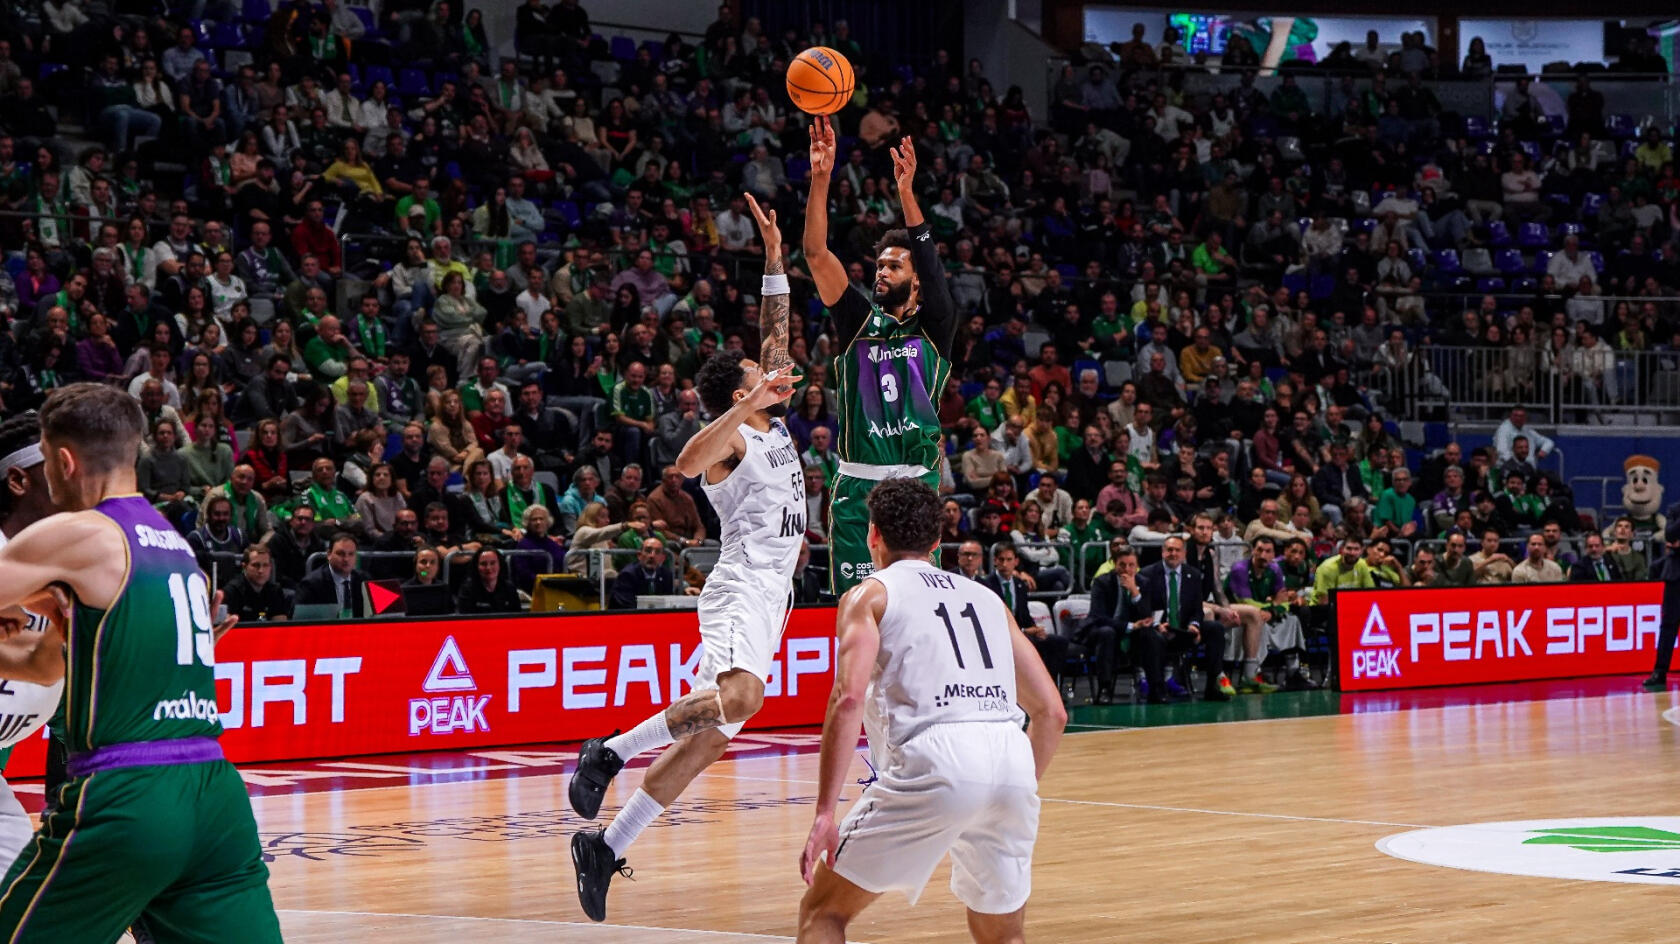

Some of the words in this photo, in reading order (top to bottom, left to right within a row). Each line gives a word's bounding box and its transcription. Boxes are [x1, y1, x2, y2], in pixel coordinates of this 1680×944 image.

[879, 345, 918, 362] Unicaja
[881, 373, 899, 403] 3
[918, 572, 955, 590] IVEY
[168, 572, 215, 667] 19
[934, 602, 994, 670] 11
[1409, 609, 1533, 663] PEAK
[1546, 604, 1679, 655] SPOR
[508, 642, 702, 714] PEAK
[1352, 648, 1402, 679] PEAK
[213, 656, 363, 730] ORT
[408, 694, 493, 737] PEAK
